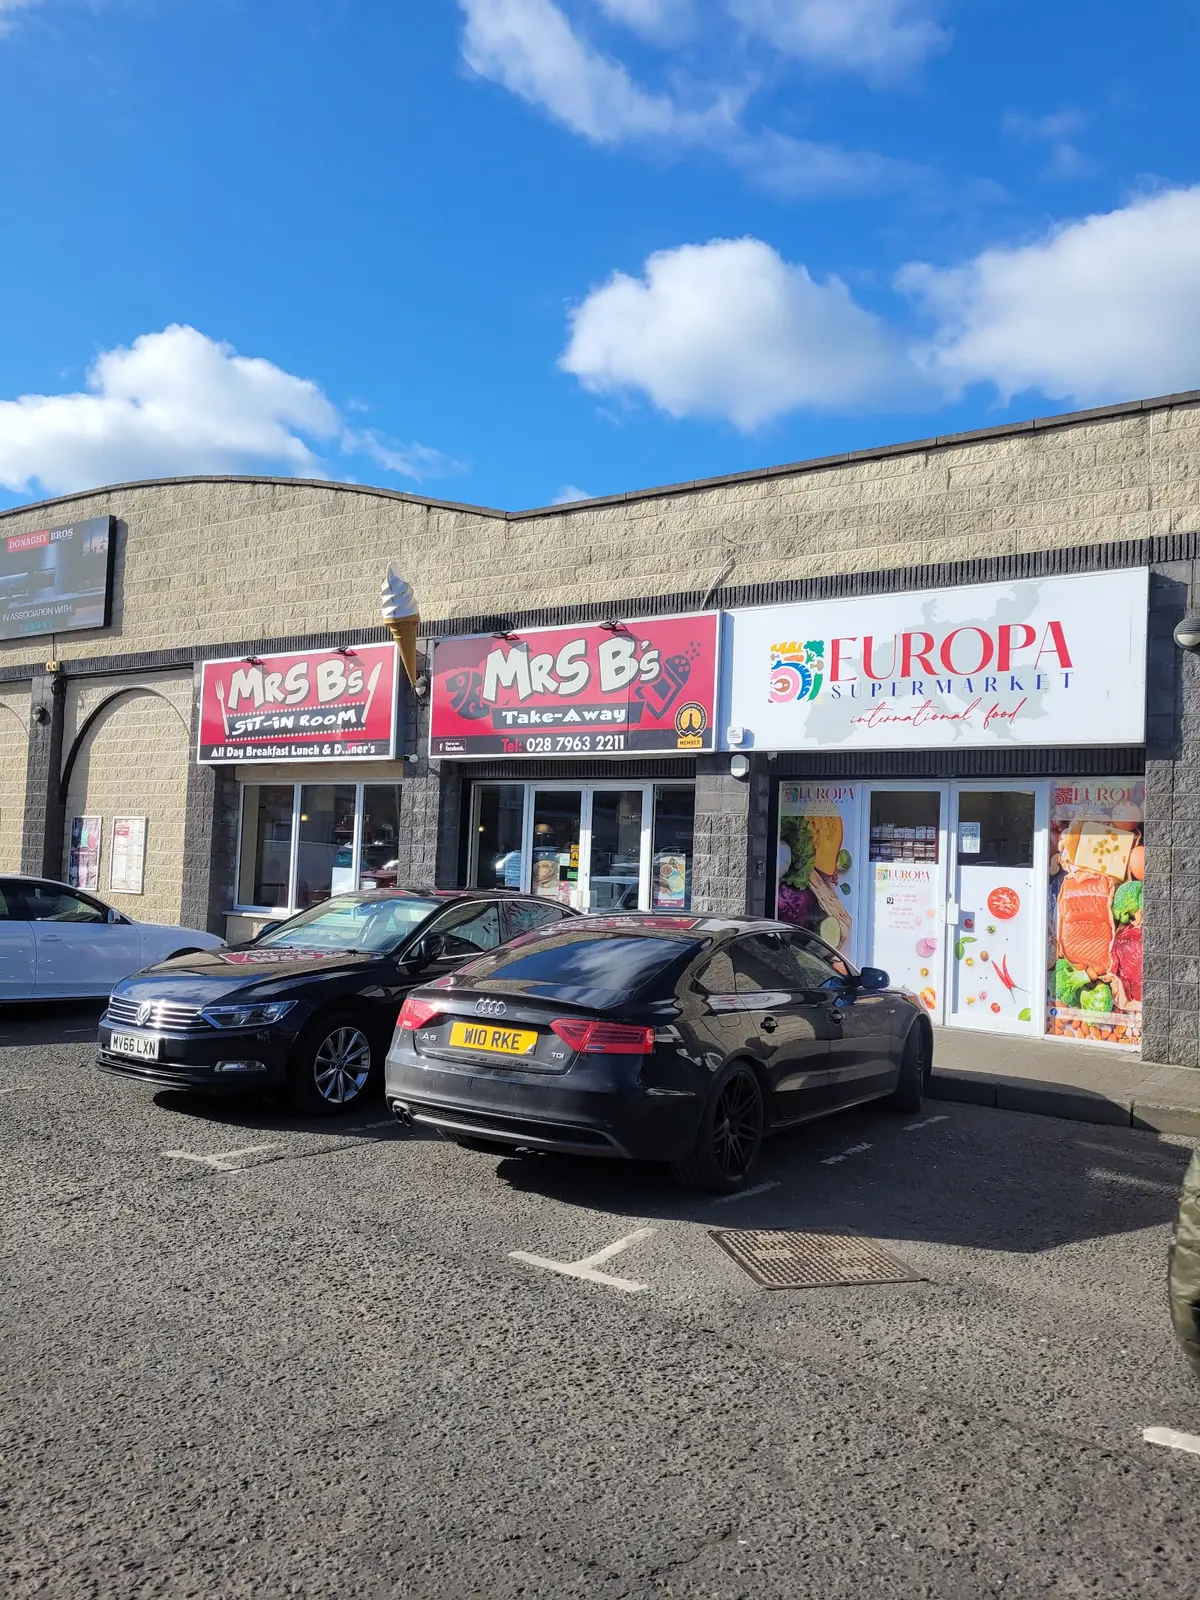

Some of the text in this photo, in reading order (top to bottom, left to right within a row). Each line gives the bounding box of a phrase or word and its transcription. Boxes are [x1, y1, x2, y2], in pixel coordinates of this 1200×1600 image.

[9, 528, 74, 549] DONAGHY BROS
[10, 607, 53, 620] ASSOCIATION
[54, 605, 72, 614] WITH
[830, 621, 1074, 682] EUROPA
[831, 672, 1074, 699] SUPERMARKET
[299, 709, 357, 727] ROOM
[502, 708, 626, 726] Take-Away
[850, 697, 1028, 729] international food
[211, 743, 376, 759] All Day Breakfast Lunch & Dner's
[502, 735, 625, 752] Tel: 028 7963 2211
[800, 788, 854, 800] EUROPA
[889, 870, 930, 880] EUROPA
[112, 1034, 156, 1056] MV66 LXN
[421, 1032, 437, 1041] A5
[464, 1027, 522, 1050] W10 RKE
